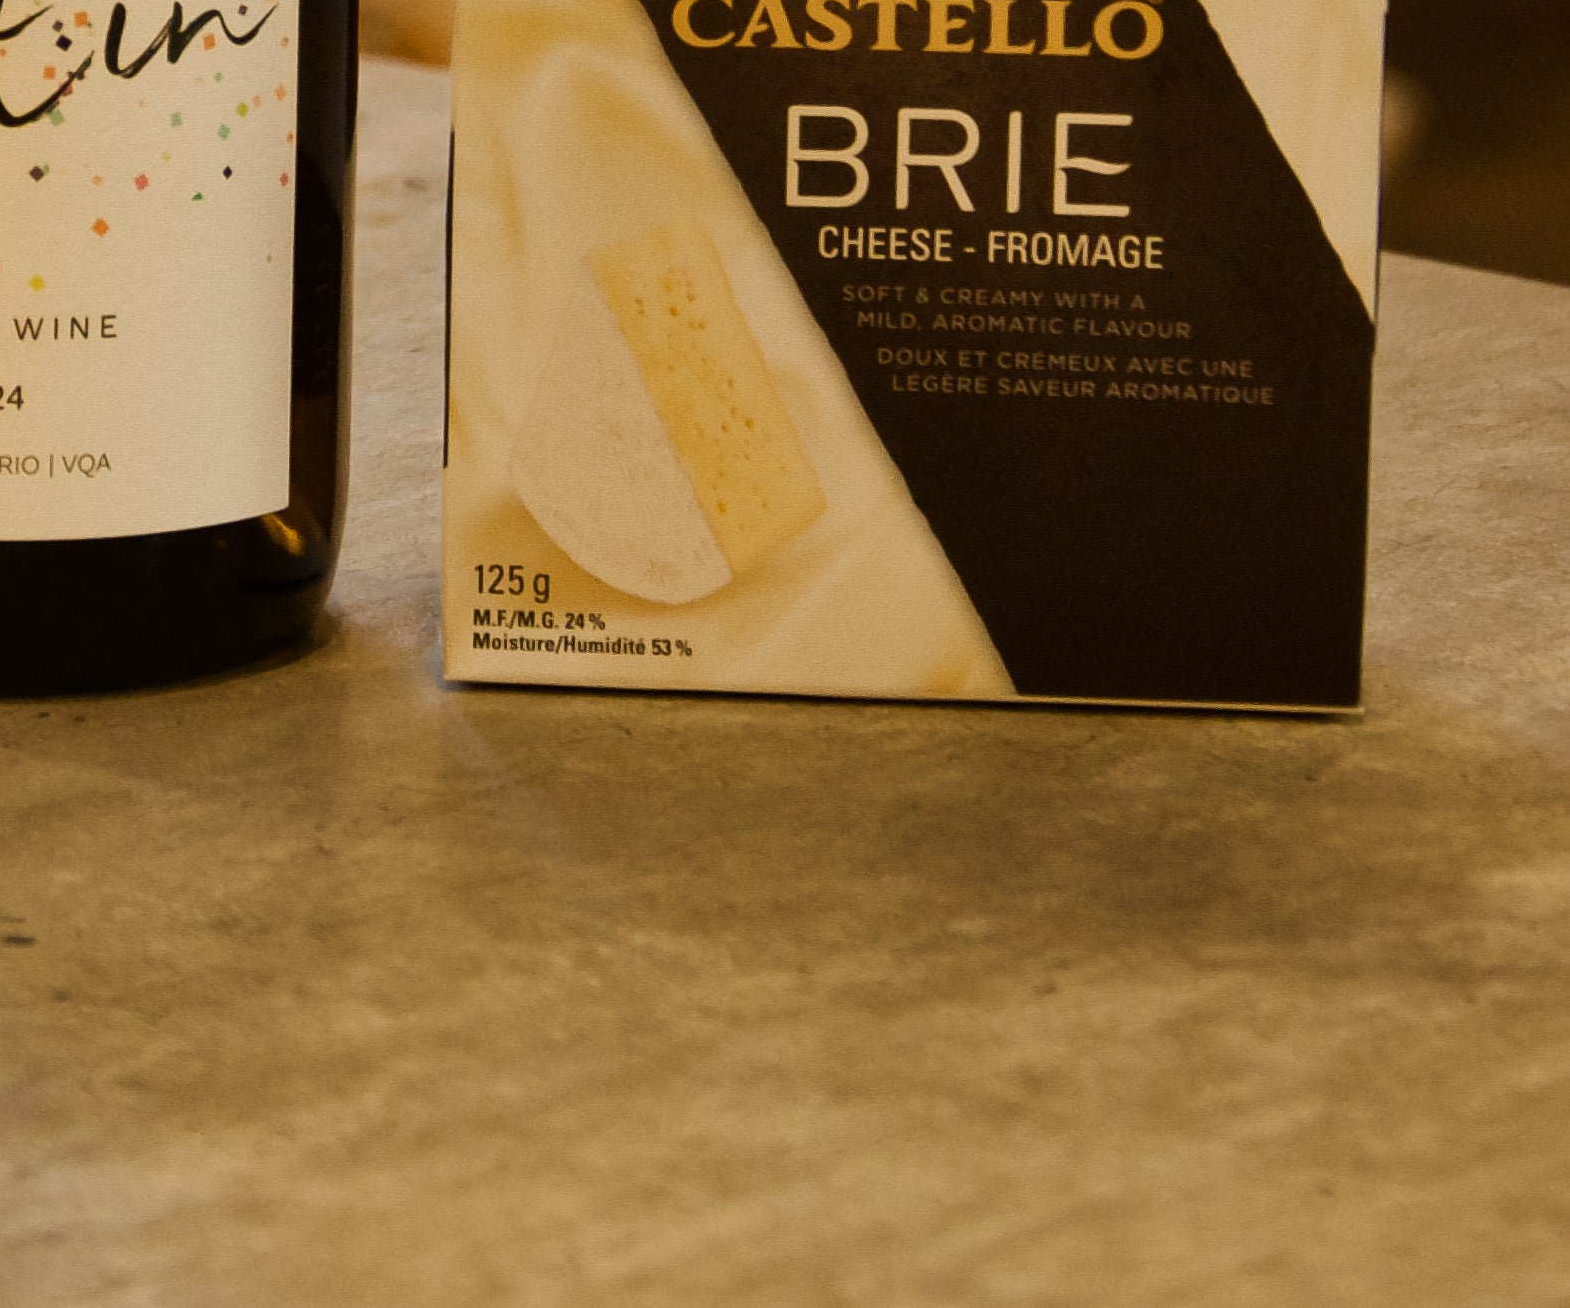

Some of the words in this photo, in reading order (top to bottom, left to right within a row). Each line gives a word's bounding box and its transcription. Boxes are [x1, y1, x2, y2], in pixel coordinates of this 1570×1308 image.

[785, 104, 1133, 217] BRIE
[818, 225, 953, 262] CHEESE
[987, 230, 1164, 269] FROMAGE
[842, 284, 906, 302] SOFT
[915, 287, 929, 304] &
[940, 288, 1044, 306] CREAMY
[1055, 291, 1119, 310] WITH
[1131, 294, 1145, 311] A
[14, 314, 117, 340] WINE
[932, 314, 1063, 335] AROMATIC
[1074, 319, 1192, 340] FLAVOUR
[878, 348, 947, 367] DOUX
[958, 350, 988, 368] ET
[997, 349, 1115, 372] CRÉMEUX
[1127, 356, 1192, 376] AVEC
[1203, 359, 1253, 378] UNE
[893, 373, 987, 394] LÉGÈRE
[998, 377, 1095, 399] SAVEUR
[1106, 382, 1274, 405] AROMATIQUE
[61, 453, 111, 477] VQA
[473, 564, 525, 596] 125
[532, 573, 550, 604] g
[472, 632, 646, 656] Moisture/Humidité
